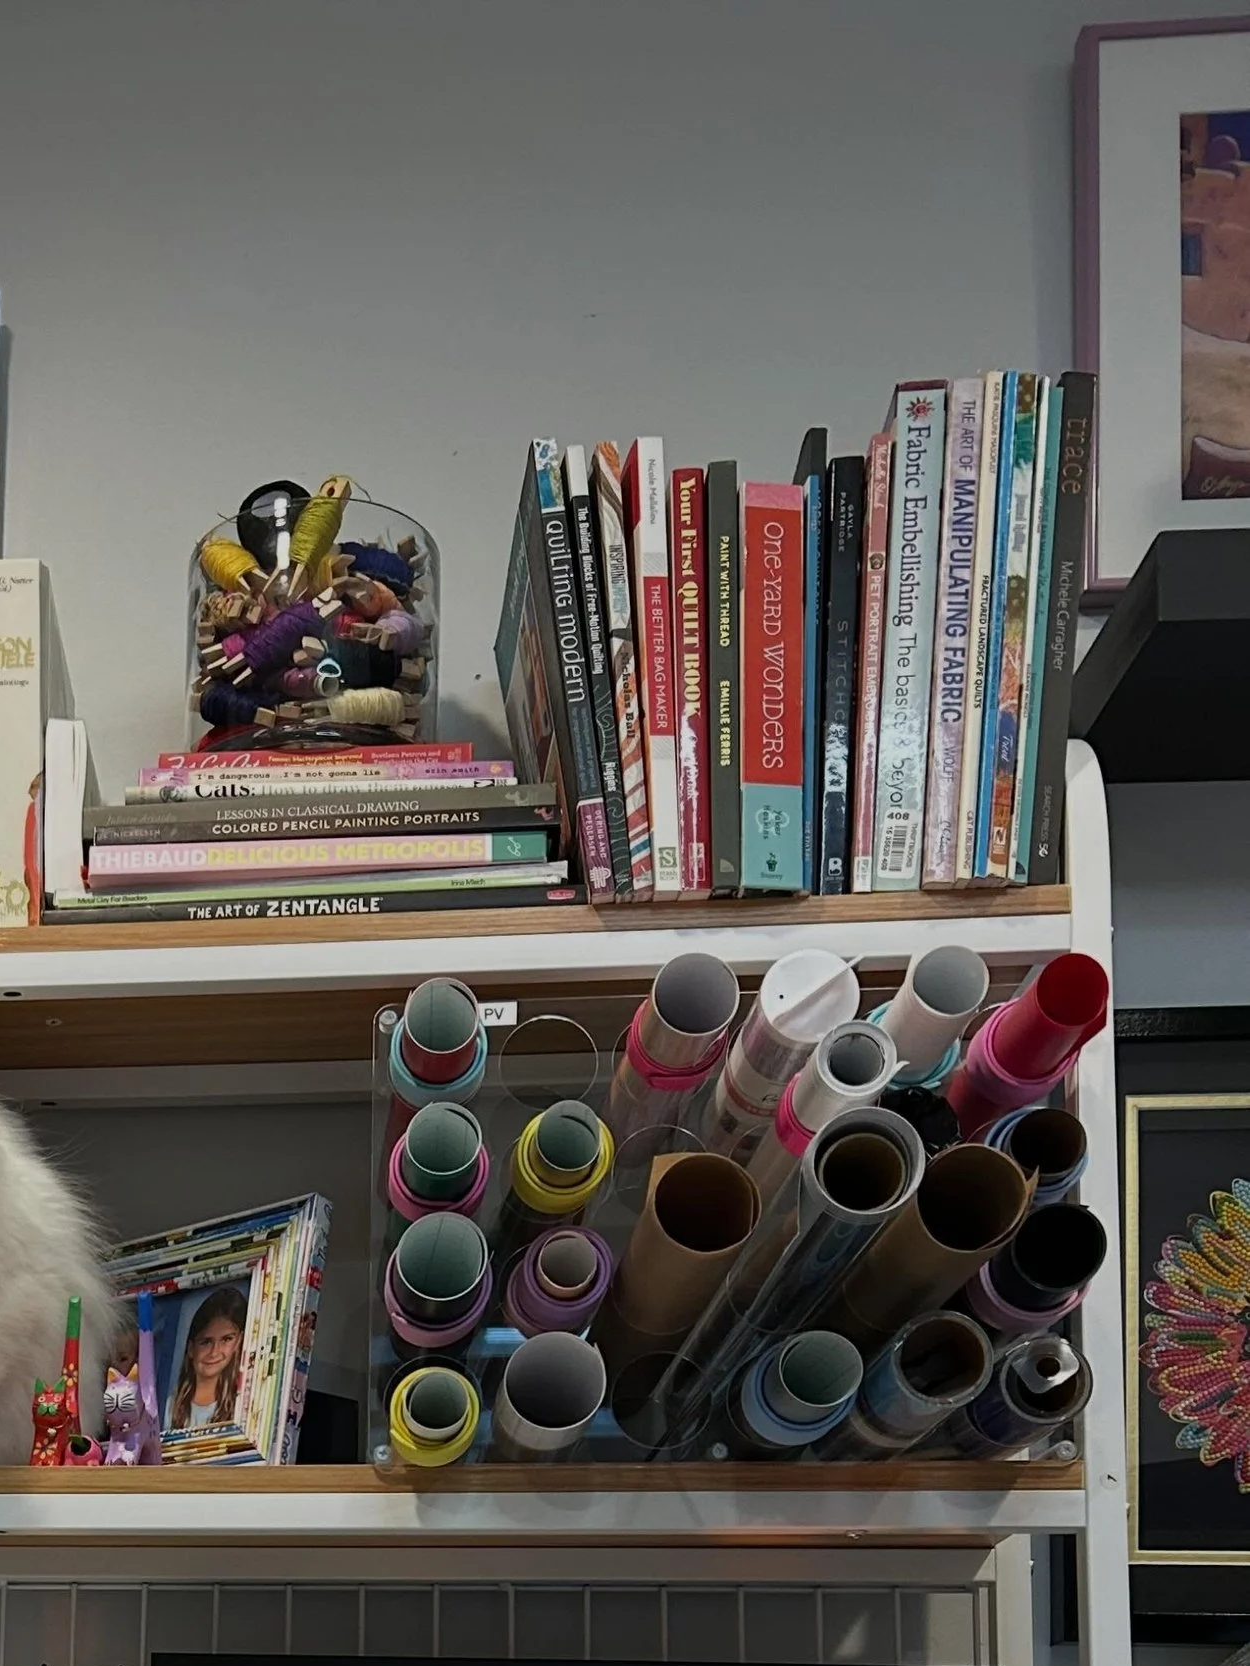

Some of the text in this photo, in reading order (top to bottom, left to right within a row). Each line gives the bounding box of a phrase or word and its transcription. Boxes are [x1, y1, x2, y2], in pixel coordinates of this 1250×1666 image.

[1061, 417, 1088, 494] trace
[846, 504, 855, 539] GAYLA
[893, 424, 932, 668] Fabric Embellishing The
[940, 400, 976, 723] THE ART OF MANIPULATING FABRIC
[677, 477, 701, 718] Your First QUILT BOOK
[720, 535, 730, 648] PAINT WITH THREAD
[867, 575, 881, 663] PET PORTRAIT
[1051, 560, 1074, 672] Michele Carragher
[651, 585, 668, 729] THE BETTER BAG MAKER
[973, 575, 990, 709] FRACTURED LANDSCAPE QUILTS
[719, 680, 731, 767] EMILLIE FERRIS
[216, 800, 420, 821] LESSONS IN CLASSICAL DRAWING
[218, 771, 271, 781] dangerous
[886, 810, 910, 821] 408
[92, 839, 485, 868] THIEBAUD DELICIOUS METROPOLIS
[212, 811, 480, 835] COLORED PENCIL PAINTING PORTRAITS
[187, 897, 381, 920] THE ART OF ZENTANGLE
[484, 1007, 505, 1020] PV
